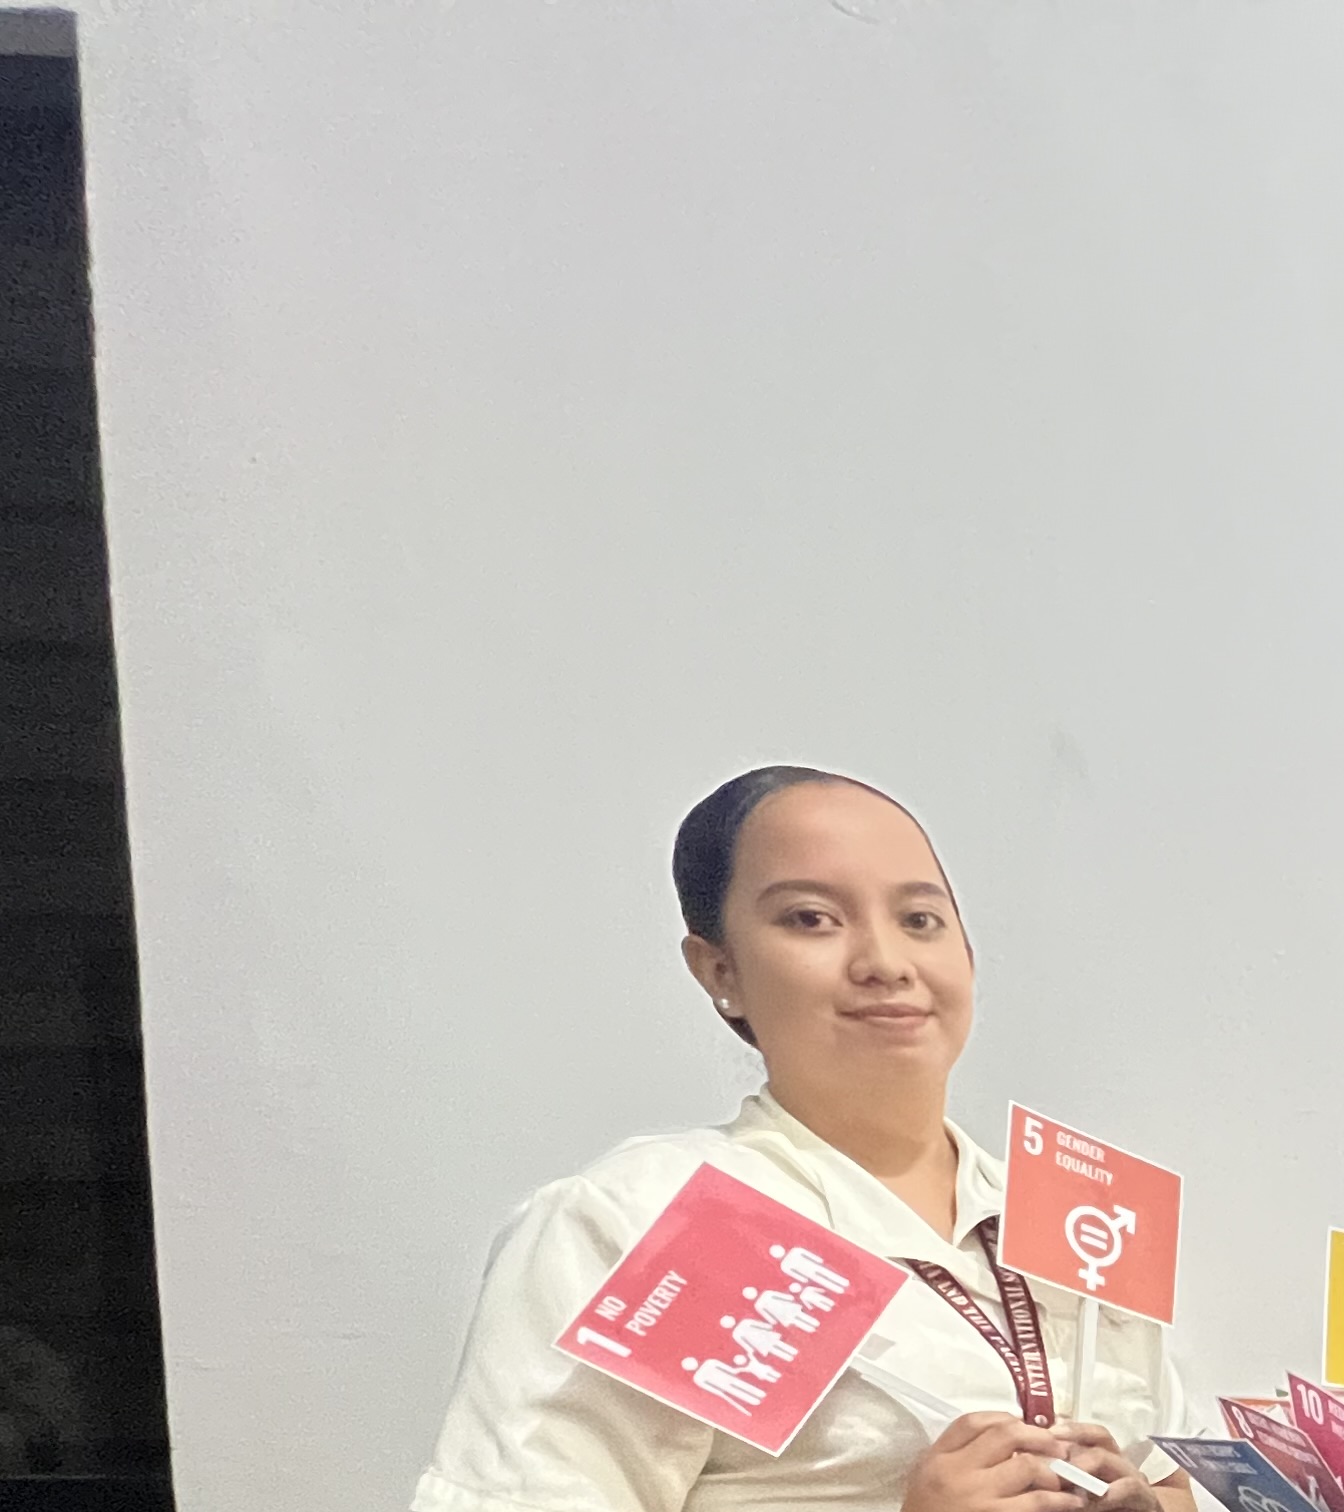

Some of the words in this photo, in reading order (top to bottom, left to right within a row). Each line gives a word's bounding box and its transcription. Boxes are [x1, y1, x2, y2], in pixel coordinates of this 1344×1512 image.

[1023, 1117, 1044, 1155] 5
[1057, 1131, 1106, 1162] GENDER
[1055, 1152, 1113, 1185] EQUALITY
[595, 1295, 627, 1321] NO
[626, 1270, 688, 1337] POVERTY
[577, 1325, 632, 1358] 1
[1297, 1384, 1324, 1425] 10
[1232, 1406, 1254, 1438] 8
